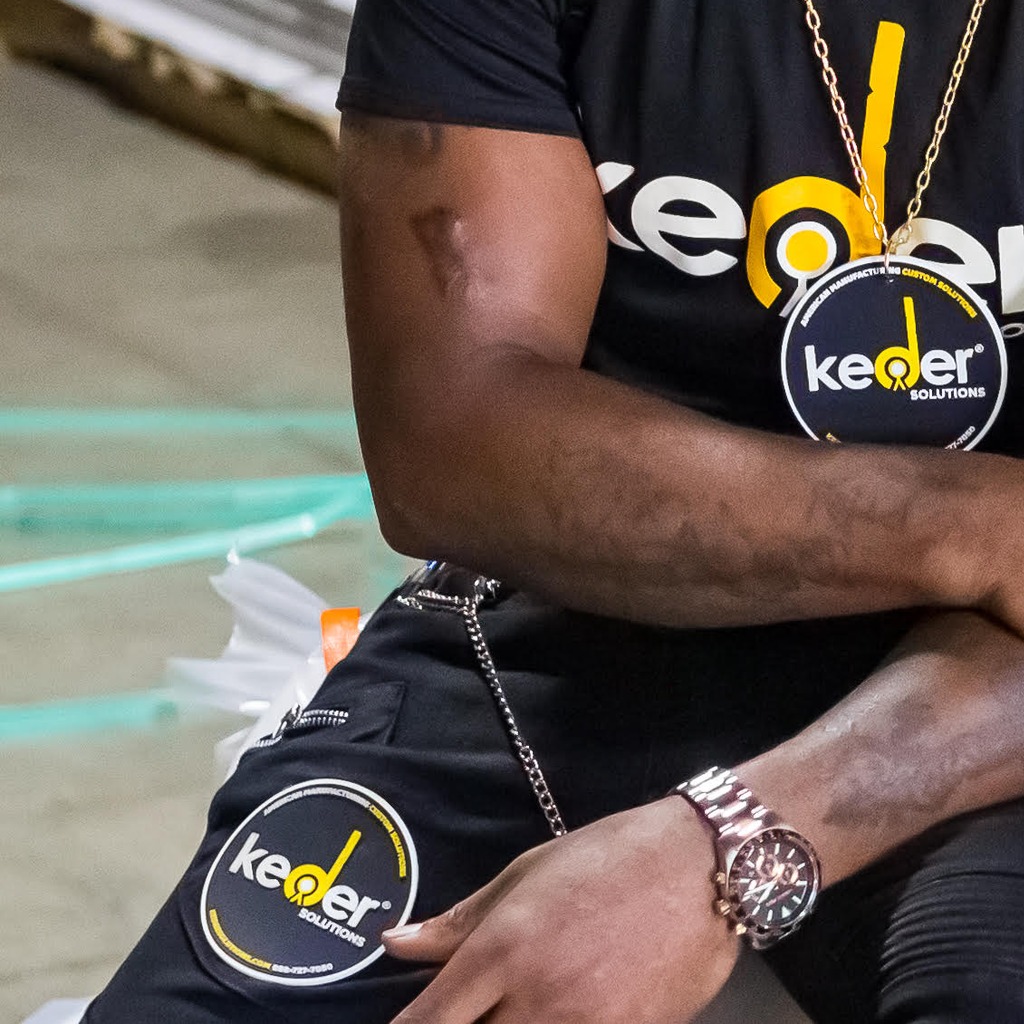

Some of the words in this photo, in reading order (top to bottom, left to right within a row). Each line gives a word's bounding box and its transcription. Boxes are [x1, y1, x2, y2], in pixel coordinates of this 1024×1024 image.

[829, 267, 900, 293] MANUFACTURNG
[902, 268, 937, 286] CUSTOM
[935, 281, 977, 318] SOLUTIONS
[910, 387, 986, 401] SOLUTIONS
[298, 908, 366, 948] SOLUTIONS
